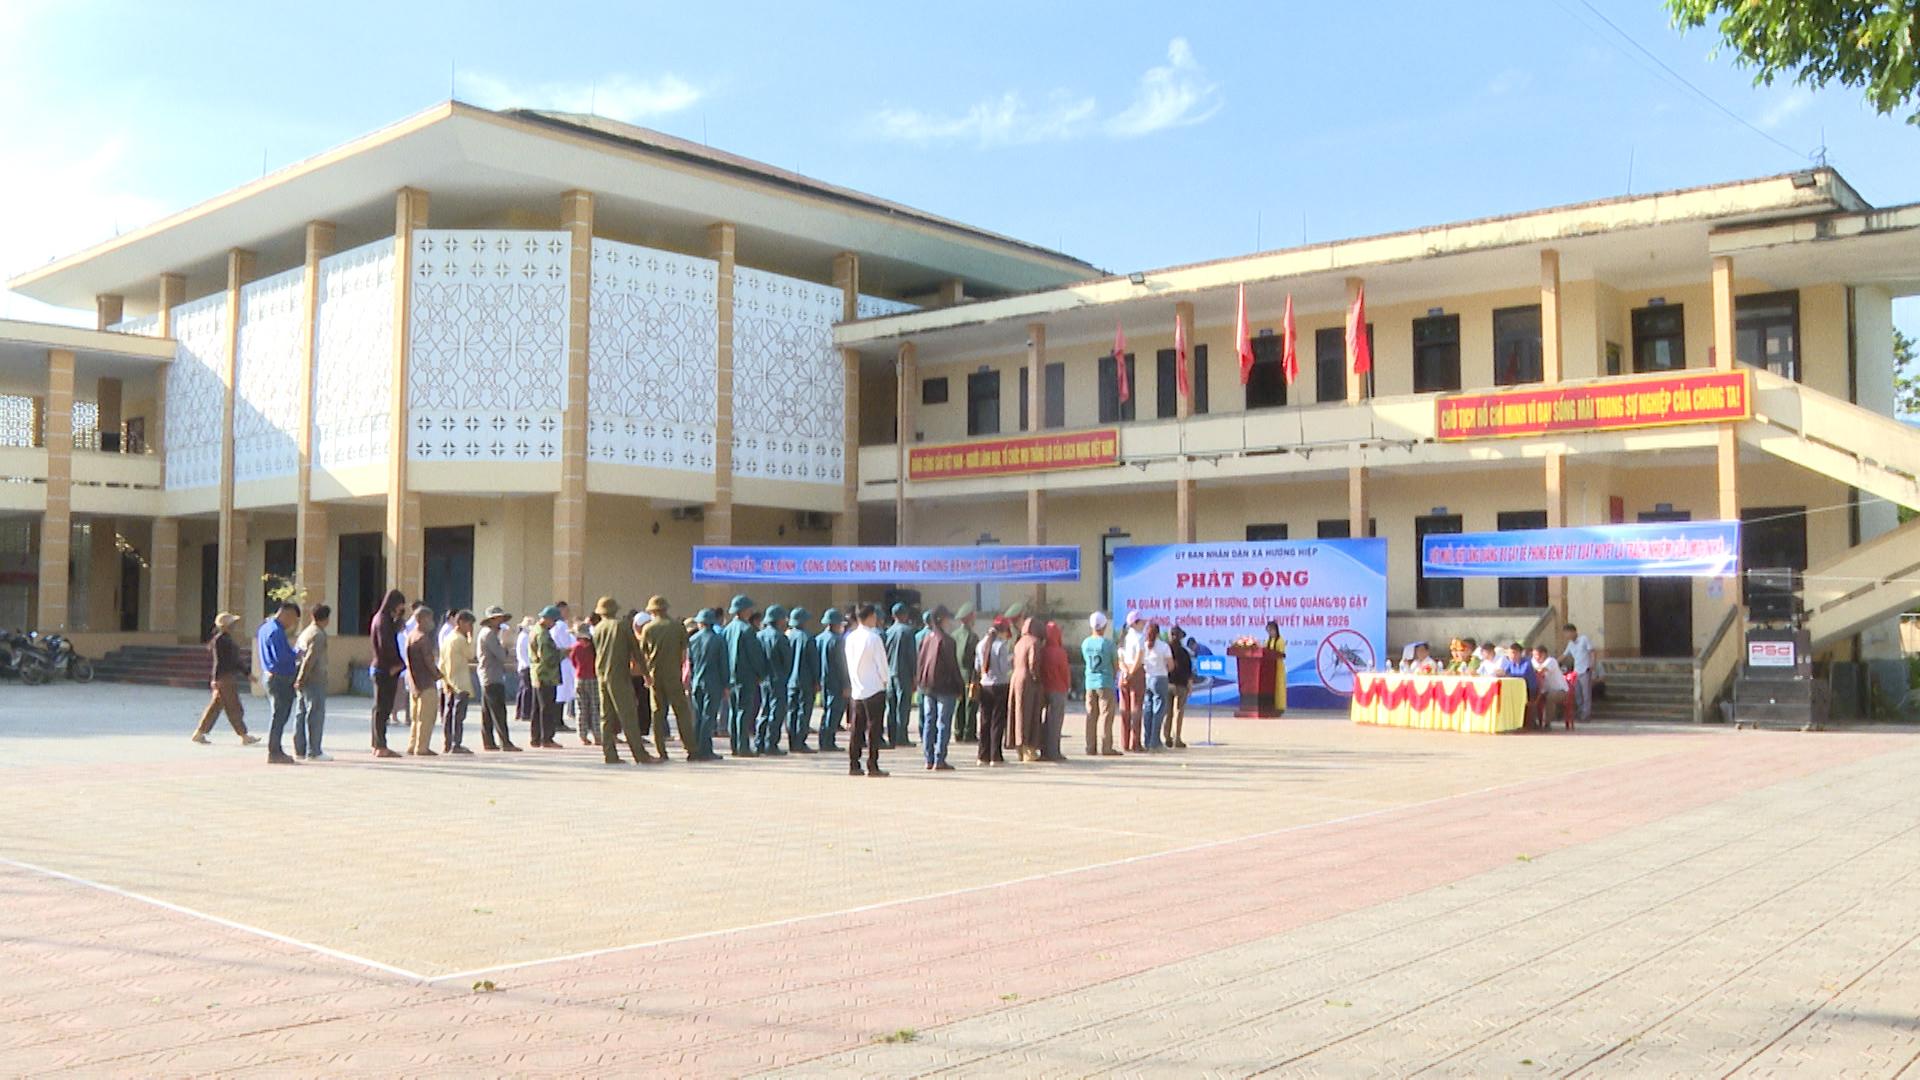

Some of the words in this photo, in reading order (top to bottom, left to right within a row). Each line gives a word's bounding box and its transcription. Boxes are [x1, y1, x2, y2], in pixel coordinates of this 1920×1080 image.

[1504, 404, 1527, 425] MINH
[1553, 393, 1576, 422] SỐNG
[1595, 396, 1624, 419] TRONG
[1639, 387, 1671, 418] NGHIỆP
[1673, 383, 1692, 412] CỦA
[1693, 384, 1724, 411] CHÚNG
[1187, 550, 1205, 559] BAN
[1206, 548, 1230, 559] NHÂN
[1231, 548, 1250, 558] DÂN
[1297, 546, 1319, 558] HIỆP
[849, 559, 876, 572] CHUNG
[878, 559, 891, 572] TAY
[893, 557, 919, 572] PHÒNG
[922, 556, 948, 572] CHỐNG
[1176, 568, 1235, 589] PHÁT
[1242, 567, 1309, 591] ĐỘNG
[1162, 596, 1172, 611] VỆ
[1174, 598, 1194, 609] SINH
[1196, 595, 1213, 609] MÔI
[1253, 595, 1272, 611] DIỆT
[1349, 594, 1368, 611] GẬY
[1175, 614, 1203, 626] CHỐNG
[1205, 614, 1228, 627] BỆNH
[1230, 613, 1246, 626] SỐT
[1303, 613, 1325, 626] NĂM
[1327, 616, 1350, 626] 2026
[1089, 655, 1102, 673] 12
